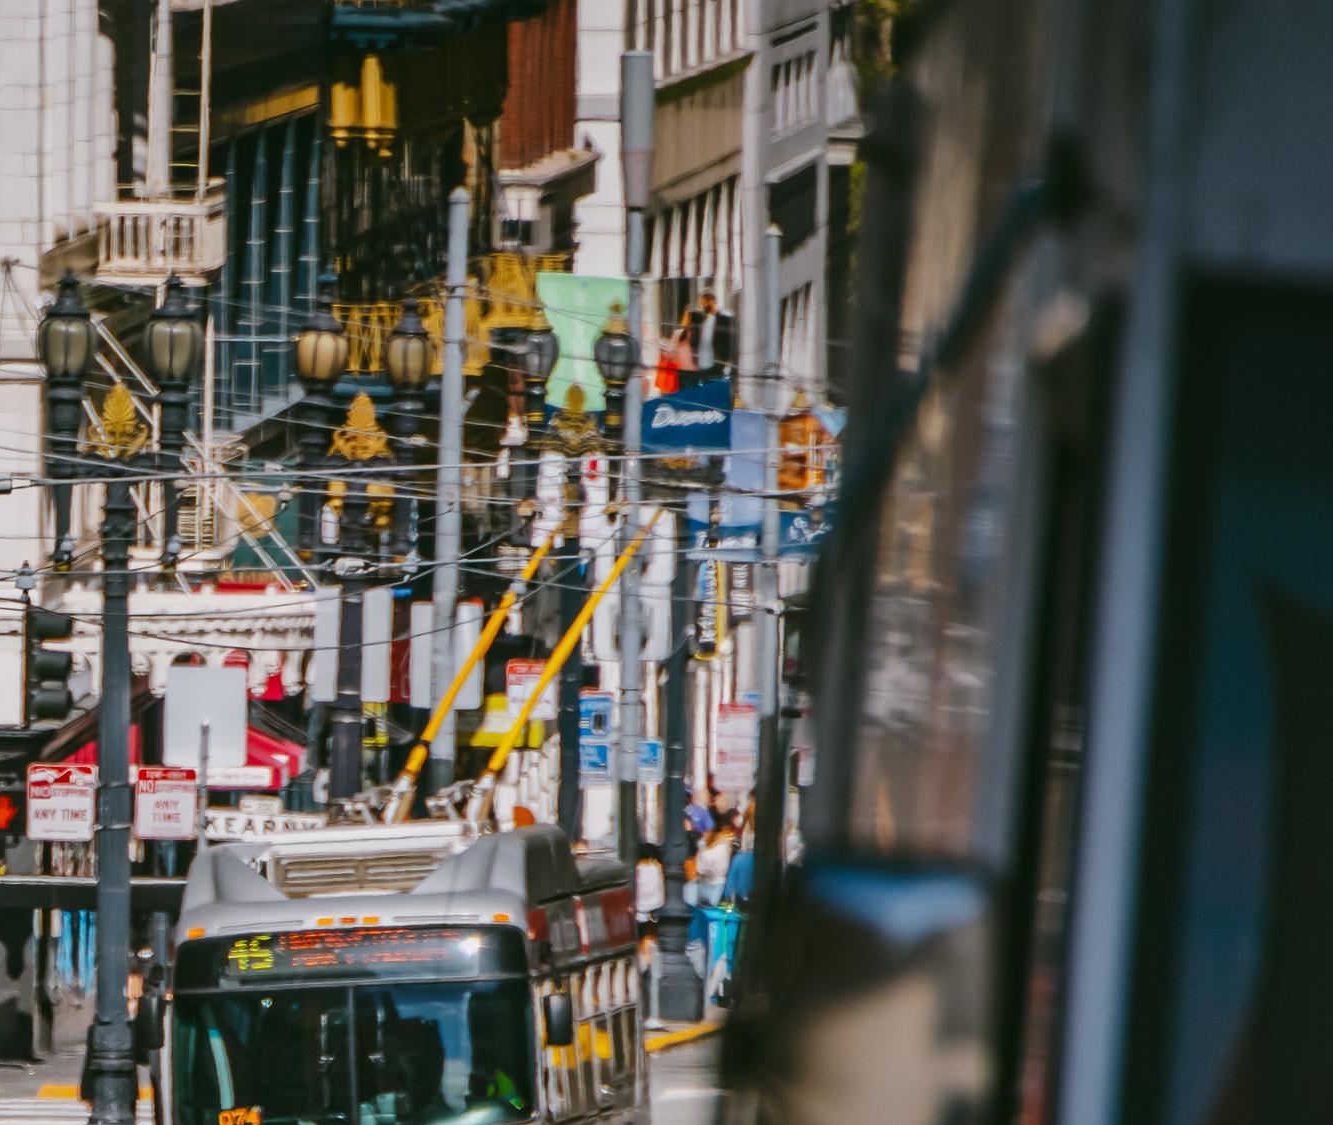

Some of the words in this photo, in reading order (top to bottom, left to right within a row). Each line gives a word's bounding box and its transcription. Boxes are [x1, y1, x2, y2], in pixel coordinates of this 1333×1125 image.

[138, 780, 155, 793] NO
[34, 809, 56, 821] ANY
[61, 809, 89, 822] TIME
[152, 812, 182, 823] TIME
